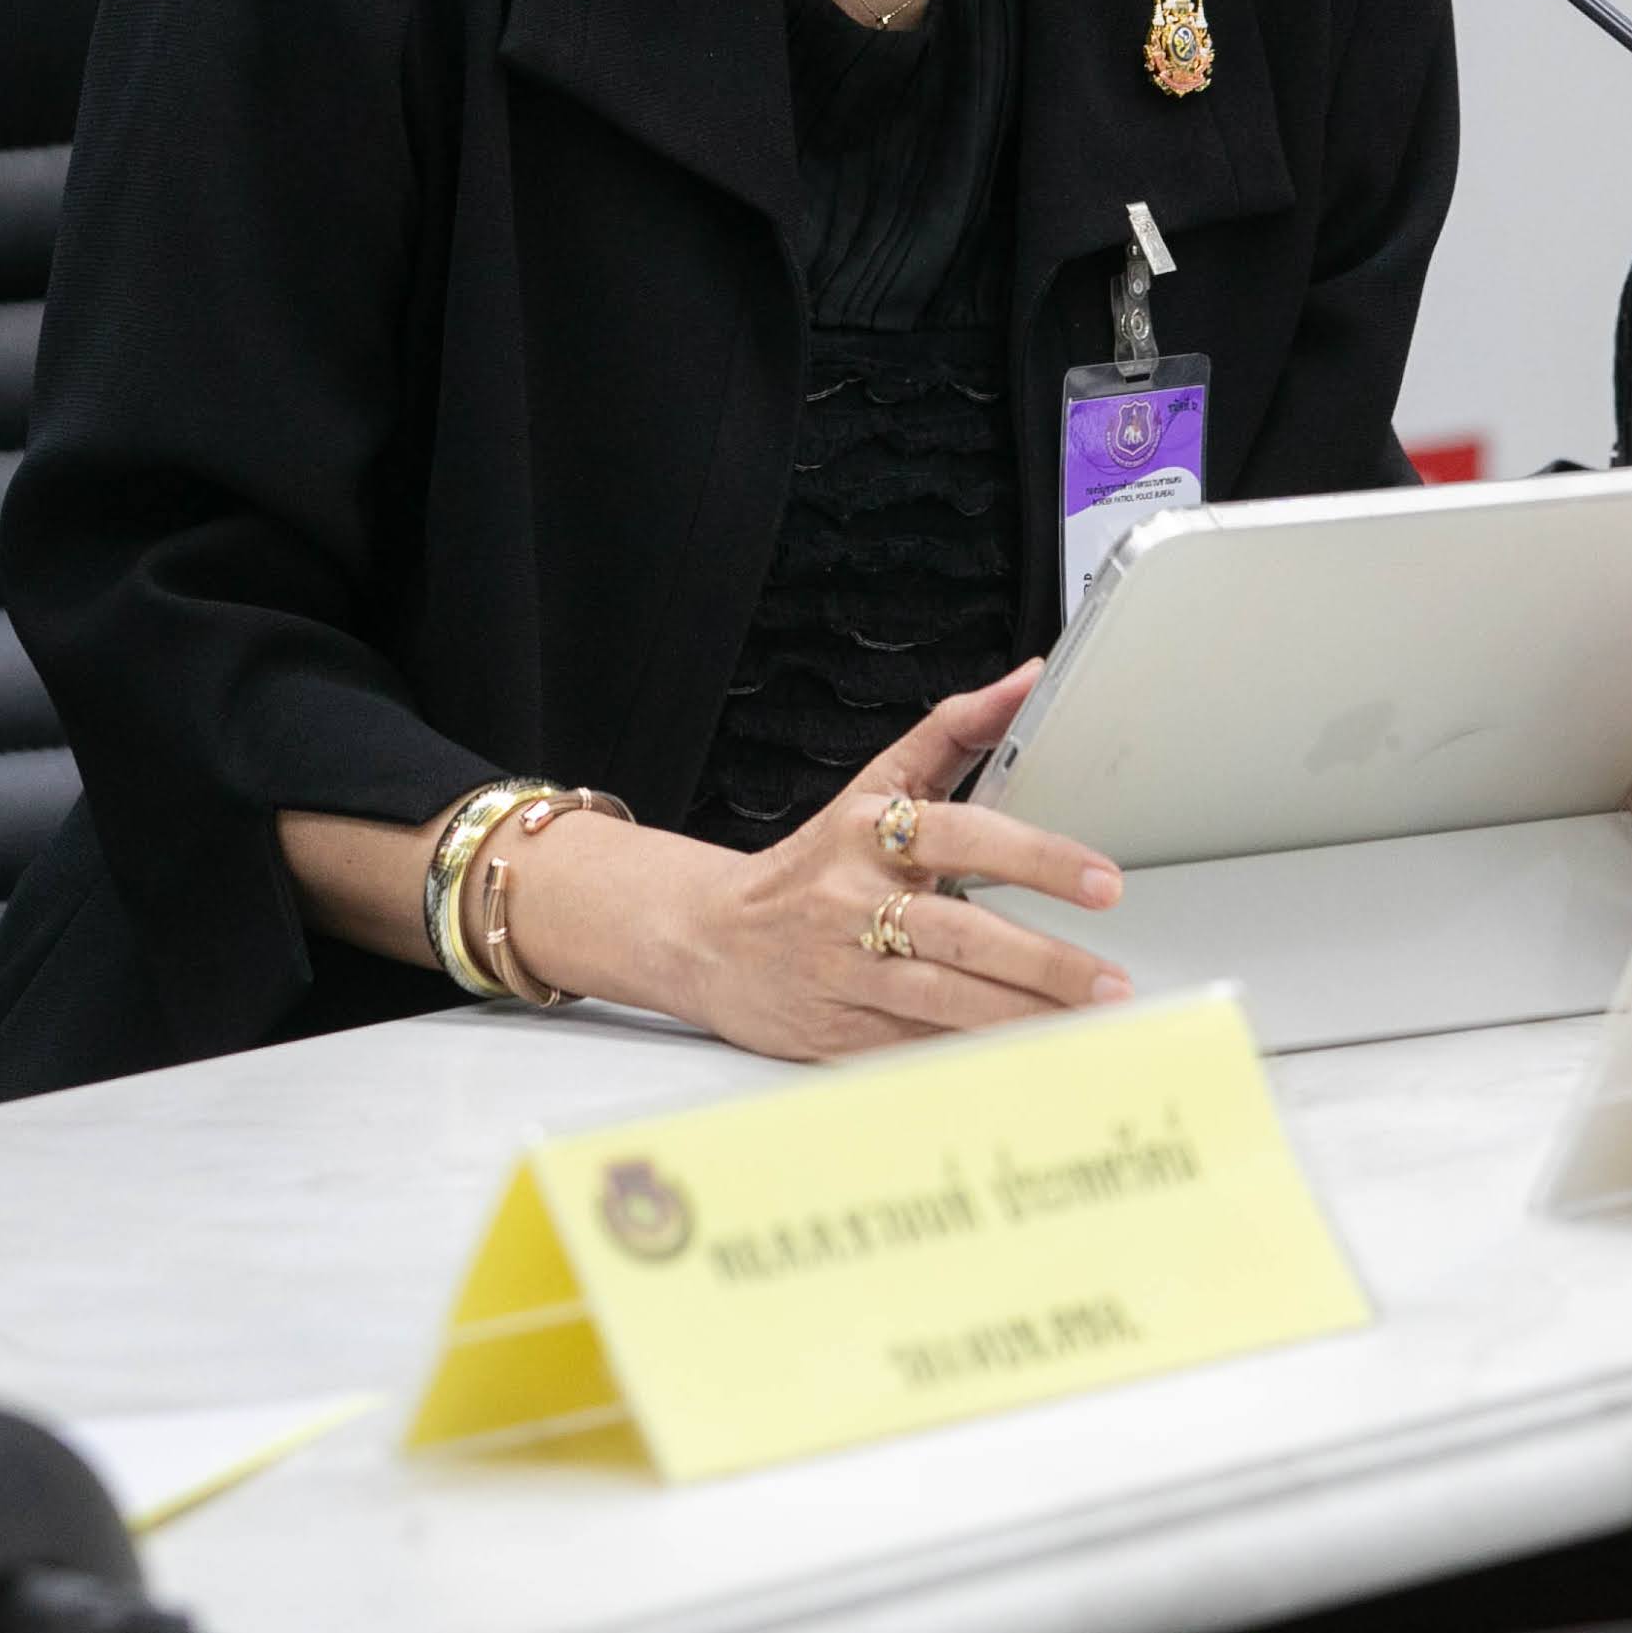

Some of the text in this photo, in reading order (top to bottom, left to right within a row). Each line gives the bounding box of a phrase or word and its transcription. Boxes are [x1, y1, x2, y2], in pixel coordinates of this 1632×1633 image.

[1114, 495, 1134, 504] PATROL
[1136, 492, 1153, 501] POLICE
[1155, 489, 1175, 499] BUREAU
